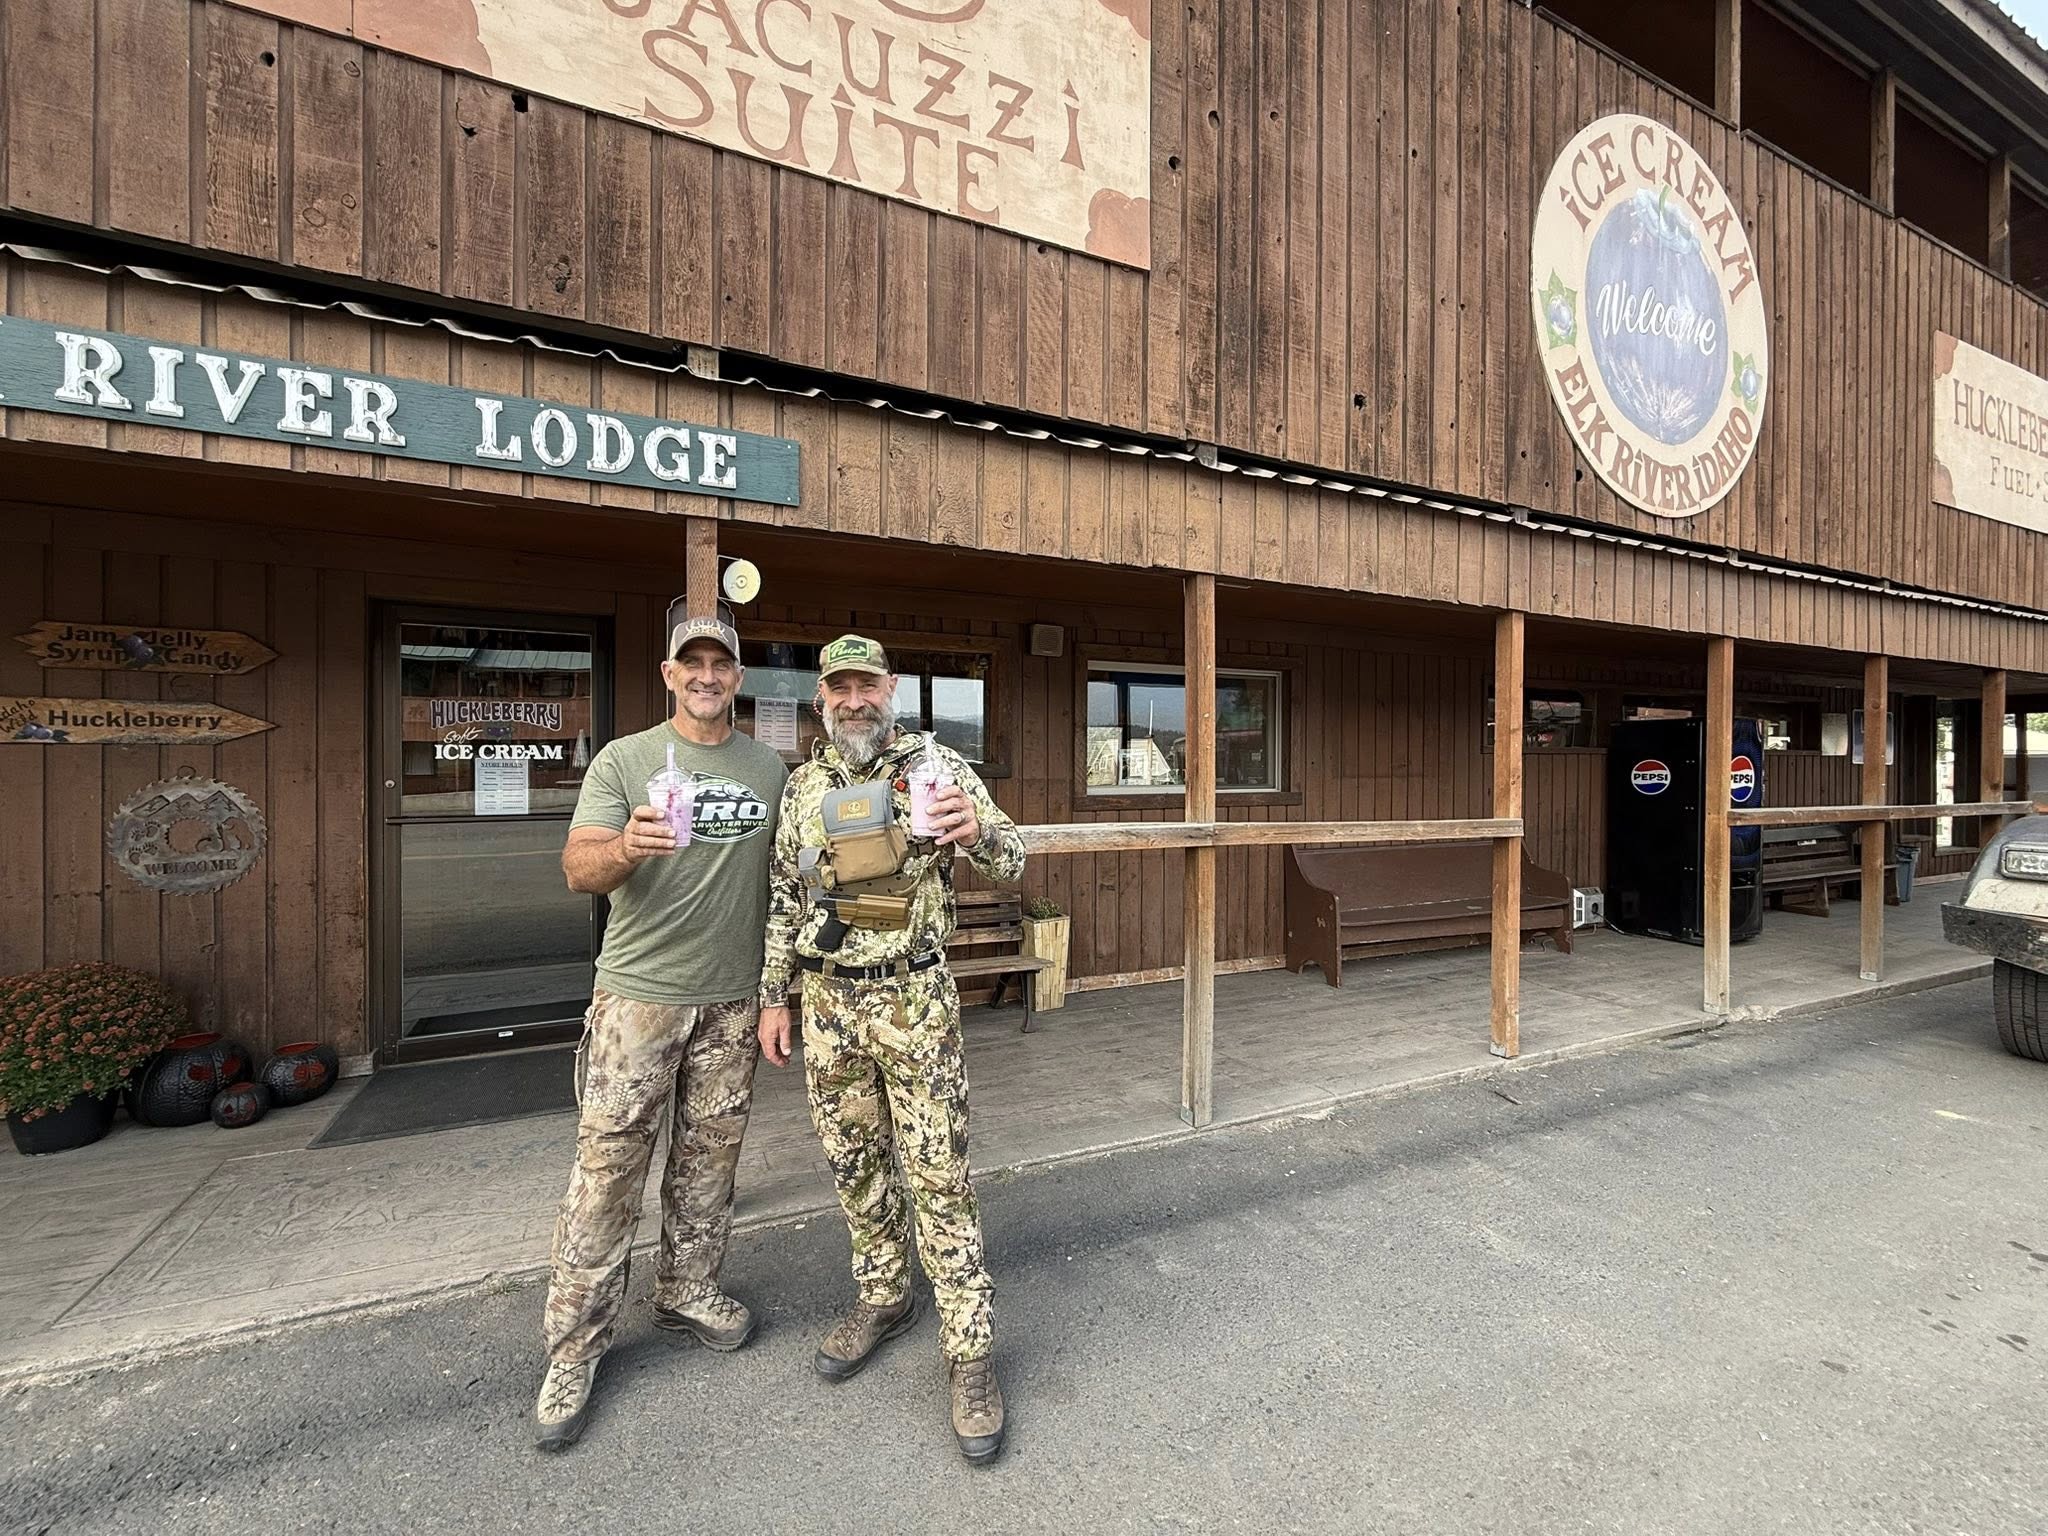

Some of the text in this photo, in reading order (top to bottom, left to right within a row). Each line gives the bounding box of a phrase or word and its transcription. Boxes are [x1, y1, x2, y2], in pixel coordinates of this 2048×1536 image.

[1630, 124, 1755, 305] CREAM
[1596, 280, 1717, 356] Welcome
[53, 331, 738, 490] RIVER LODGE
[1556, 356, 1616, 466] ELK
[59, 626, 209, 650] Jam Jelly
[47, 641, 244, 670] Syrup Candy
[0, 700, 36, 721] daho
[48, 709, 222, 731] Huckleberry
[430, 700, 562, 731] HUCKLEBERRY
[443, 726, 484, 744] Soft
[434, 744, 563, 760] ICE CREAM
[1633, 773, 1669, 781] PEPSI
[693, 801, 768, 821] RO
[144, 858, 238, 876] WELCOME
